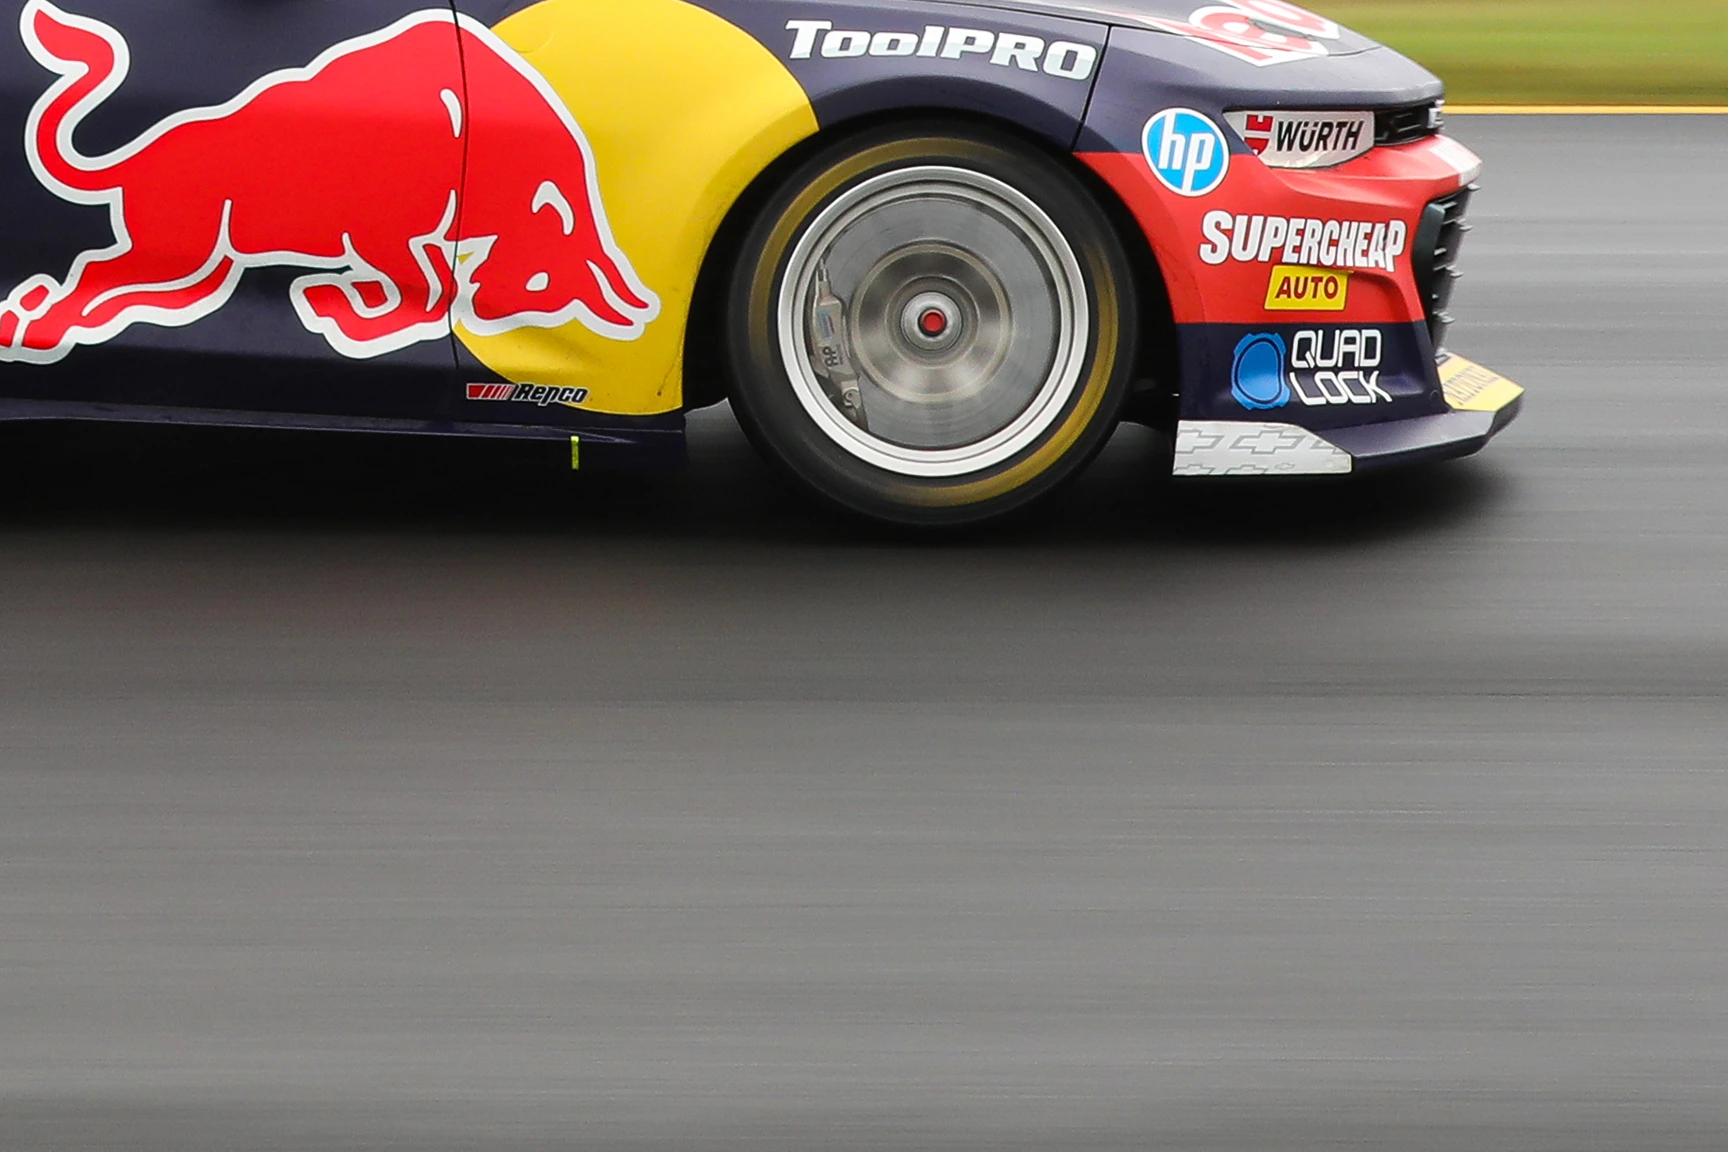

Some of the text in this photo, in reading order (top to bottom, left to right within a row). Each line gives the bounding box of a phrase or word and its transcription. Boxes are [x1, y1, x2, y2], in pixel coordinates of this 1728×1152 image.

[785, 19, 1098, 81] ToolPRO
[1158, 110, 1216, 193] hp
[1276, 119, 1364, 153] WÜRTH
[1198, 210, 1407, 272] SUPERCHEAP
[1274, 275, 1339, 300] AUTO
[1290, 329, 1382, 368] QUAD
[512, 382, 591, 406] Repco
[1289, 370, 1393, 406] LOCK
